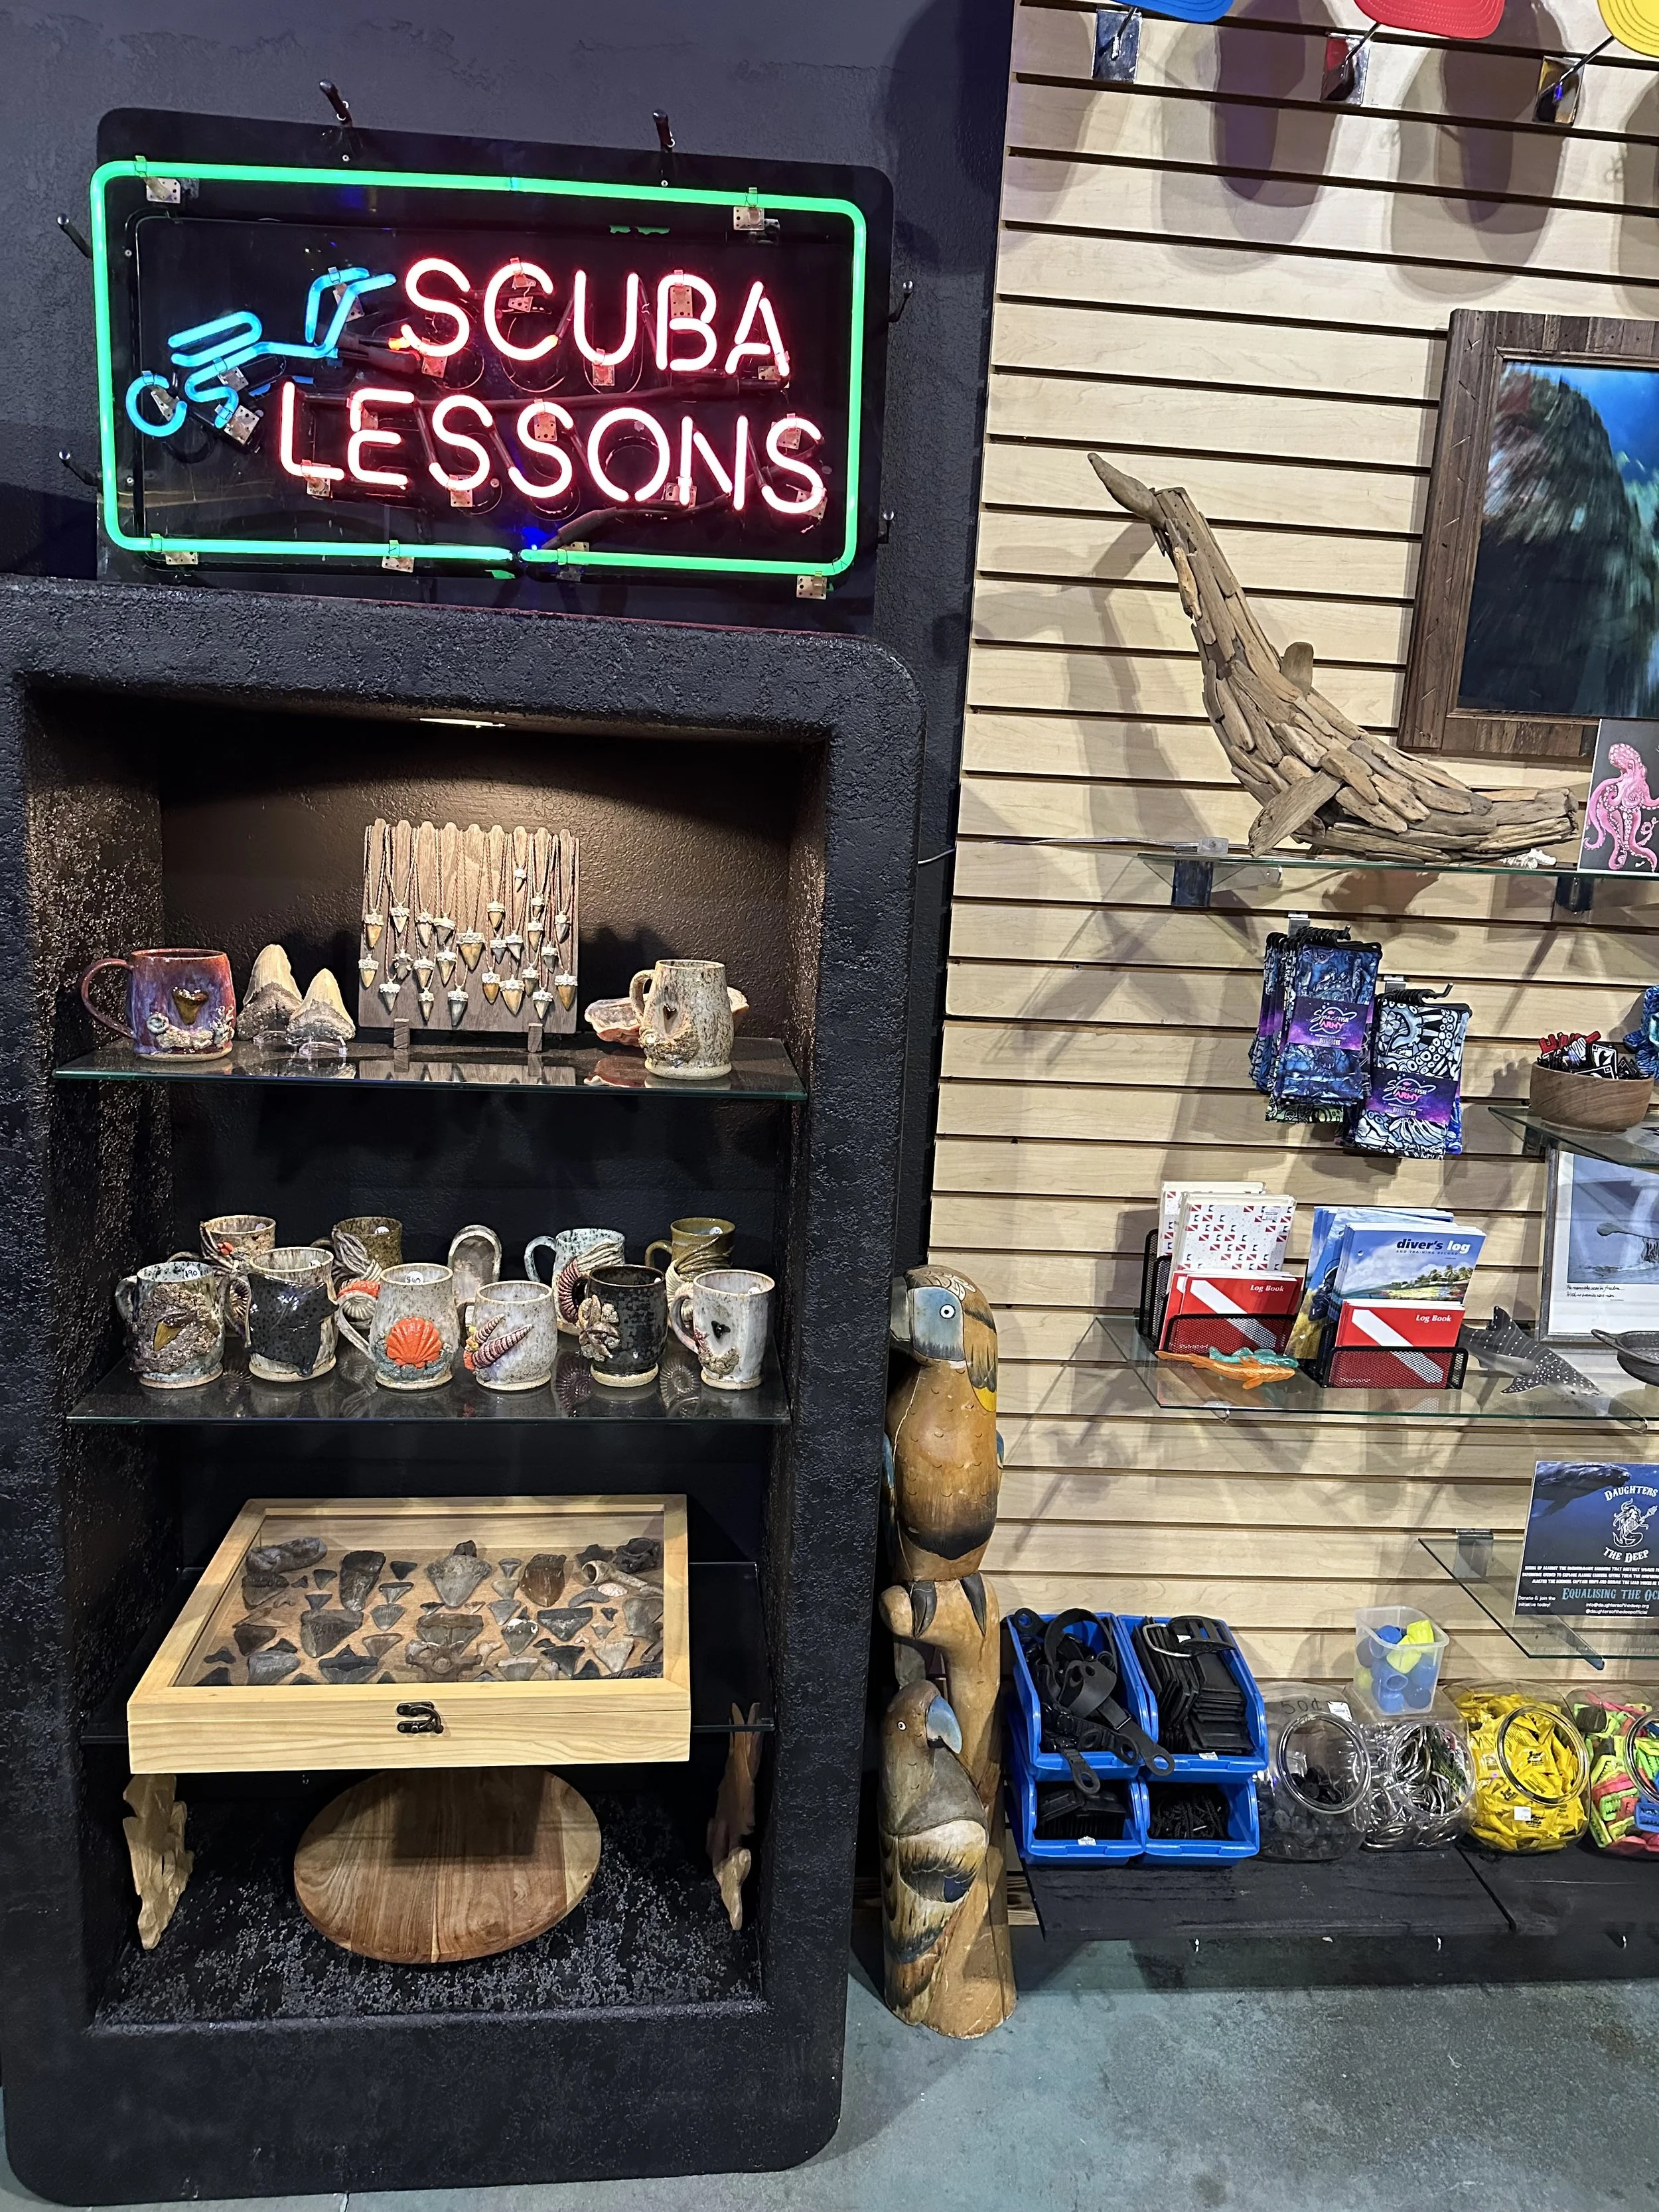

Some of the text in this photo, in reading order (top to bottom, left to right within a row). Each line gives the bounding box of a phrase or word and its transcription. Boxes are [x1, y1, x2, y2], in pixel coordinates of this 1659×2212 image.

[399, 256, 791, 377] SCUBA
[279, 380, 828, 515] LESSONS
[1396, 1238, 1471, 1254] diver's log
[1415, 1314, 1431, 1323] Log
[1604, 1485, 1658, 1501] DAUGHTERS
[1603, 1547, 1649, 1563] THE DEEP
[1561, 1587, 1617, 1600] EQUALISING
[1621, 1589, 1641, 1599] THE
[1281, 1698, 1323, 1714] 50¢
